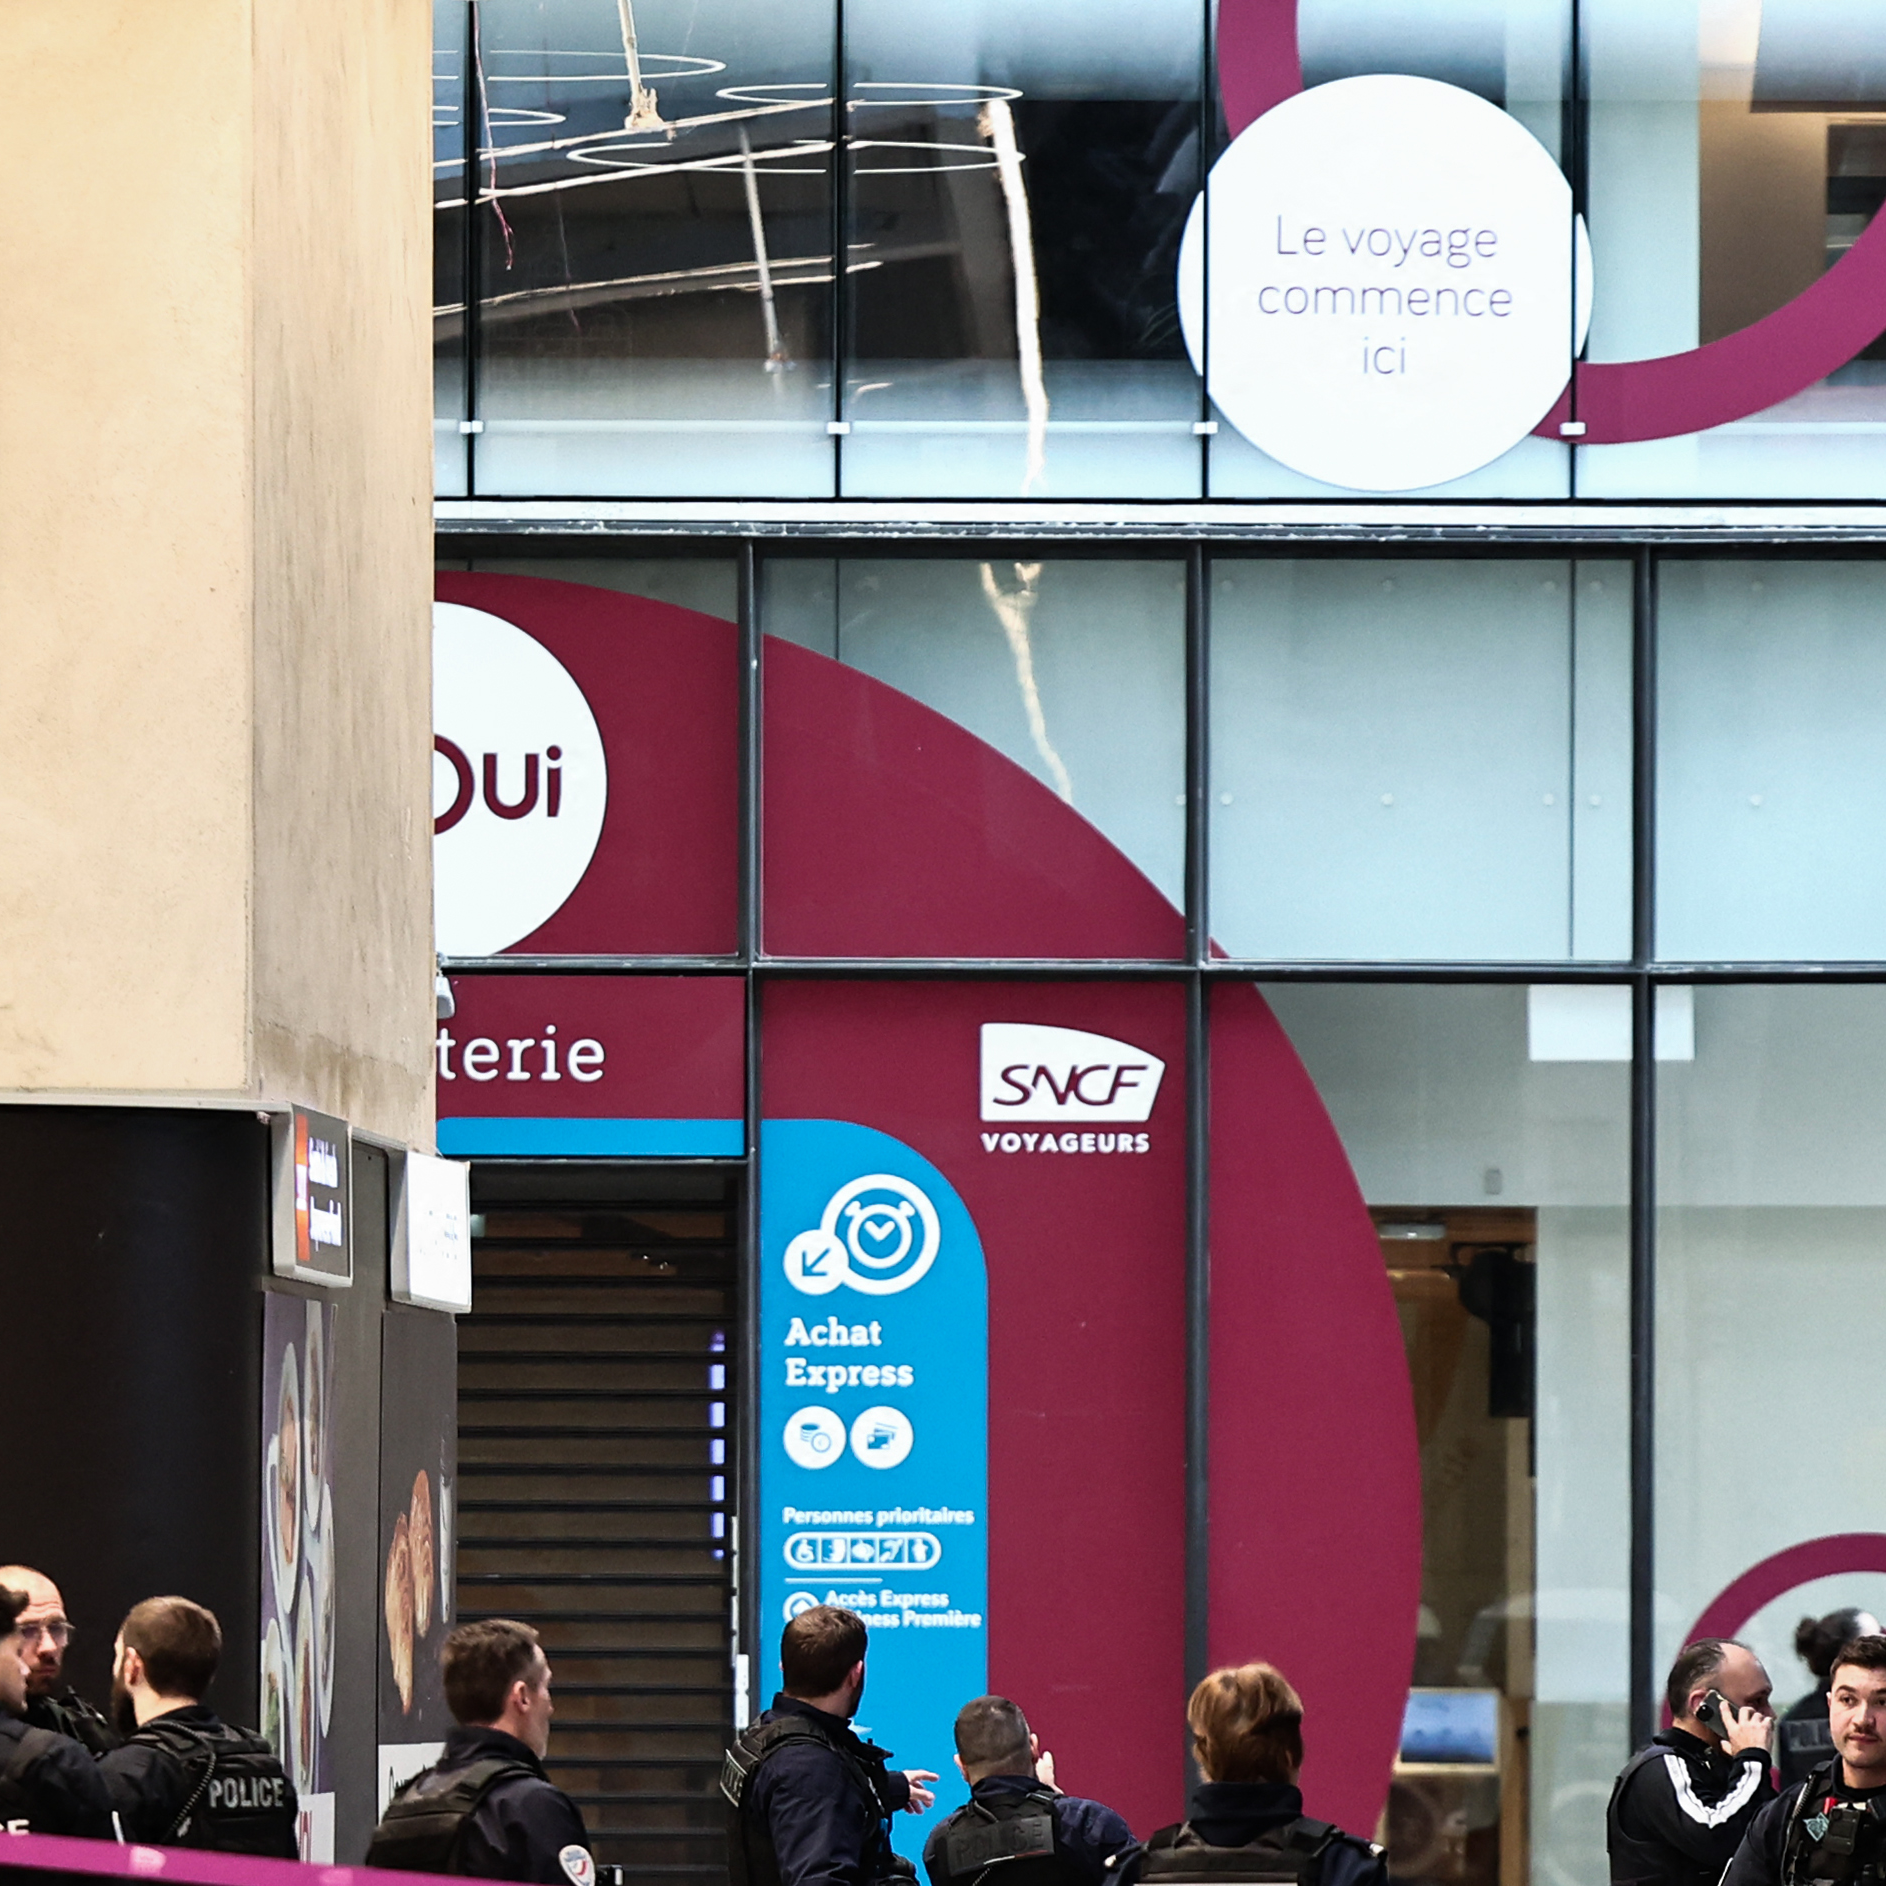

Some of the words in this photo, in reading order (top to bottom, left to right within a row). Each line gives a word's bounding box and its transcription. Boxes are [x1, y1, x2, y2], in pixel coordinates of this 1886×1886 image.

[1276, 215, 1326, 258] Le
[1343, 222, 1499, 269] voyage
[1259, 284, 1513, 317] commence
[1362, 334, 1407, 376] ici
[992, 1063, 1150, 1107] SNCF
[981, 1132, 1150, 1153] VOYAGEURS
[784, 1317, 882, 1348] Achat
[784, 1358, 914, 1393] Express
[782, 1506, 873, 1525] Personnes
[876, 1506, 975, 1528] prioritaires
[824, 1589, 878, 1607] Accès
[880, 1590, 950, 1611] Express
[902, 1608, 983, 1628] Première
[209, 1777, 285, 1809] POLICE
